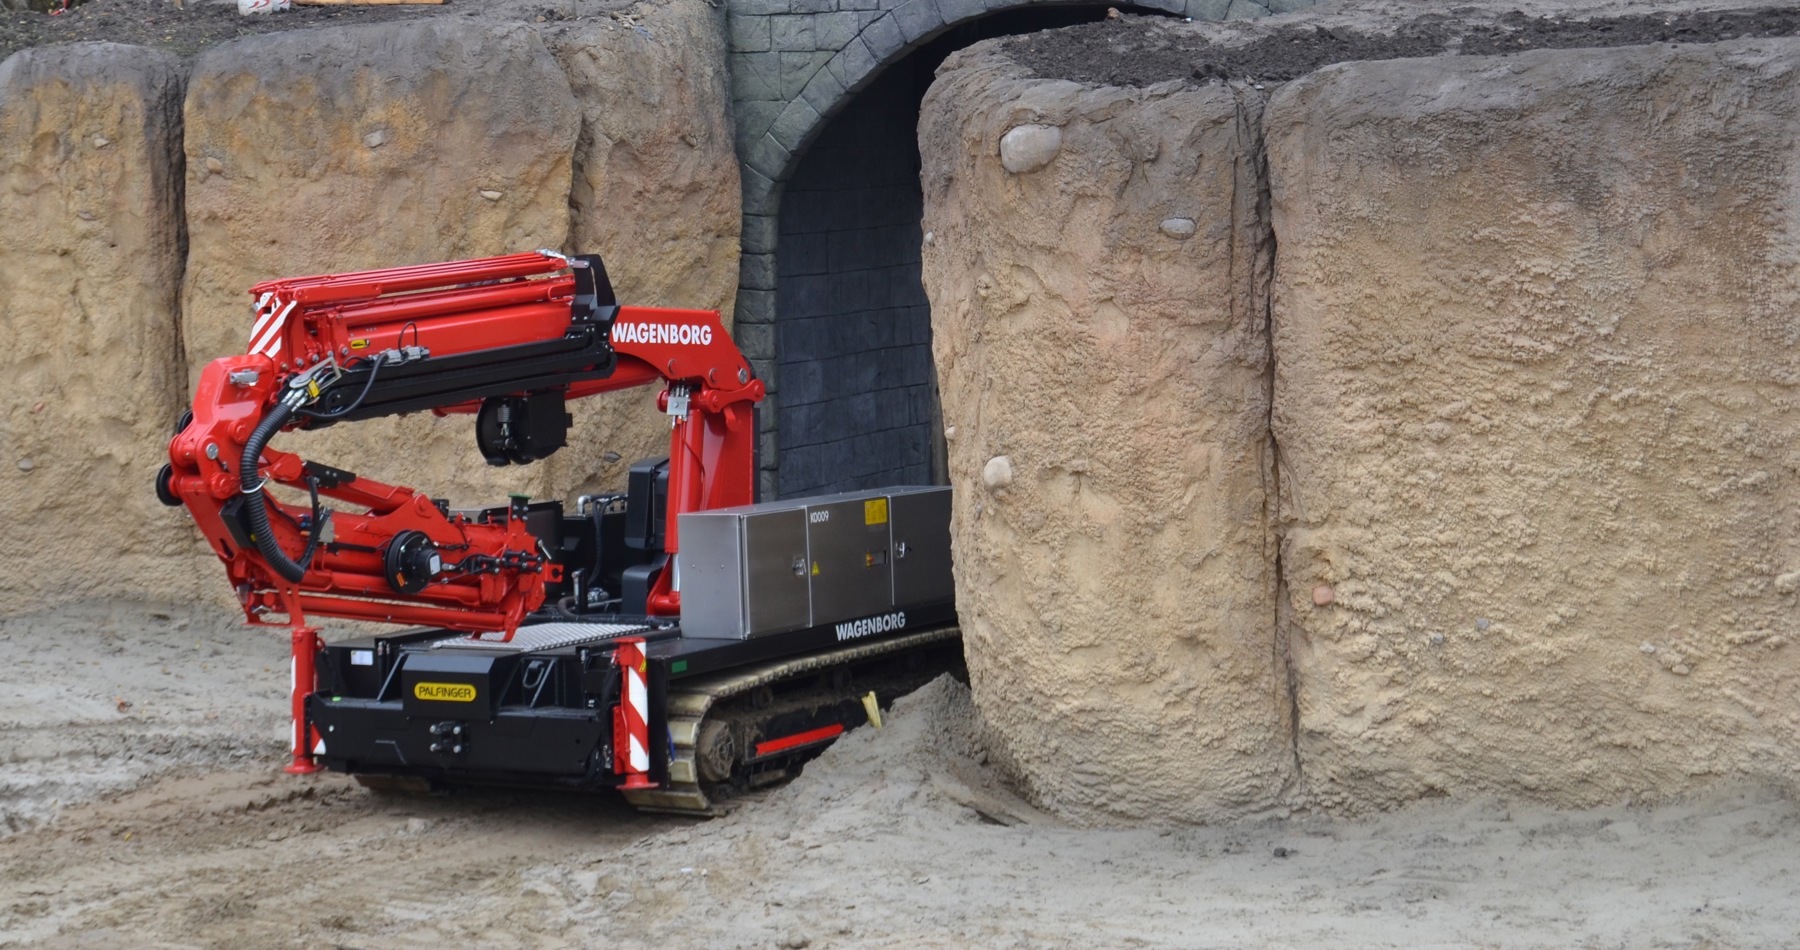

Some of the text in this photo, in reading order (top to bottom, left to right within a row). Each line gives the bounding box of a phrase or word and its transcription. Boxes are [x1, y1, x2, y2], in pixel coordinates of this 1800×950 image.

[612, 323, 711, 345] WAGENBORG
[836, 612, 905, 641] WAGENBORG
[418, 687, 472, 698] PALFINGER
